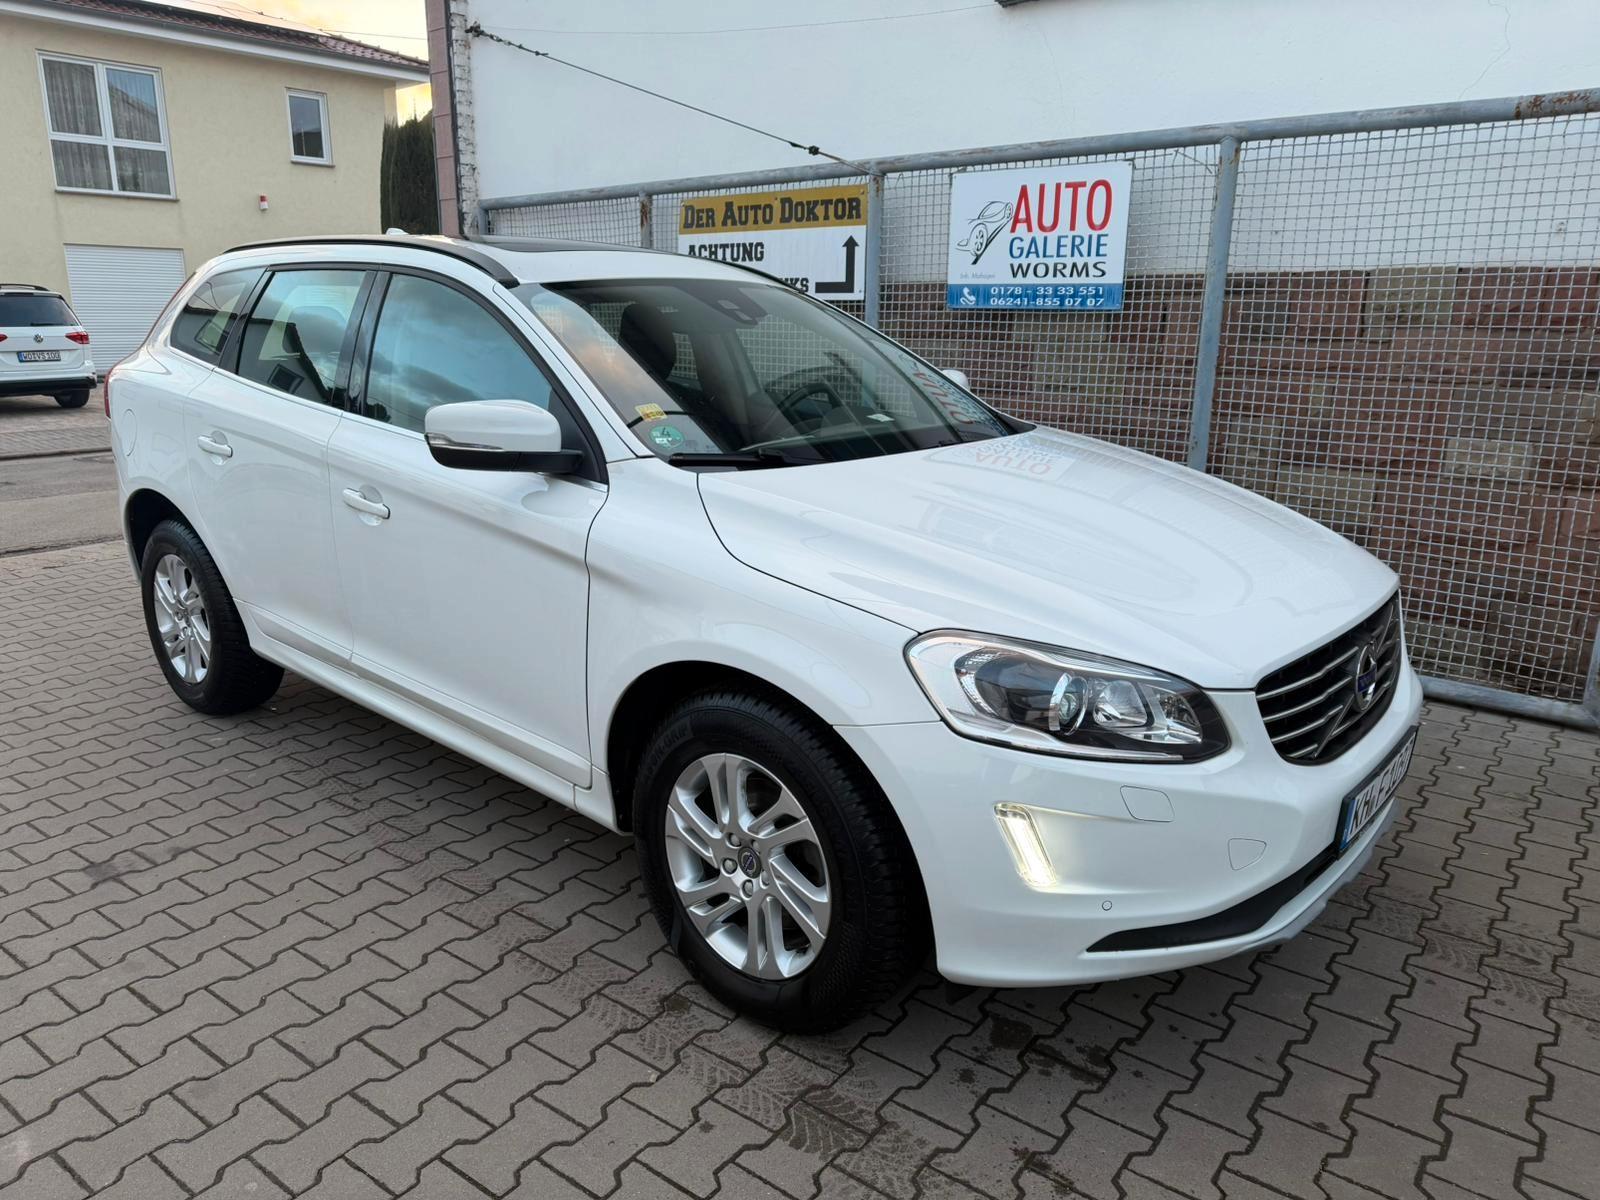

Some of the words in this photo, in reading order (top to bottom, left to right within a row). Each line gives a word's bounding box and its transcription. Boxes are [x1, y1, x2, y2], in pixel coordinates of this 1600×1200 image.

[683, 204, 716, 229] DER
[721, 200, 774, 227] AUTO
[779, 196, 862, 223] DOKTOR
[1009, 179, 1113, 233] AUTO
[687, 241, 765, 262] ACHTUNG
[1009, 234, 1109, 259] GALERIE
[1009, 261, 1107, 279] WORMS
[990, 286, 1023, 295] 0178
[1036, 286, 1053, 295] 33
[1057, 286, 1074, 295] 33
[1078, 286, 1104, 295] 551
[990, 298, 1060, 307] 06241-855
[1065, 298, 1082, 307] 07
[1086, 298, 1105, 307] 07
[660, 427, 671, 438] 4
